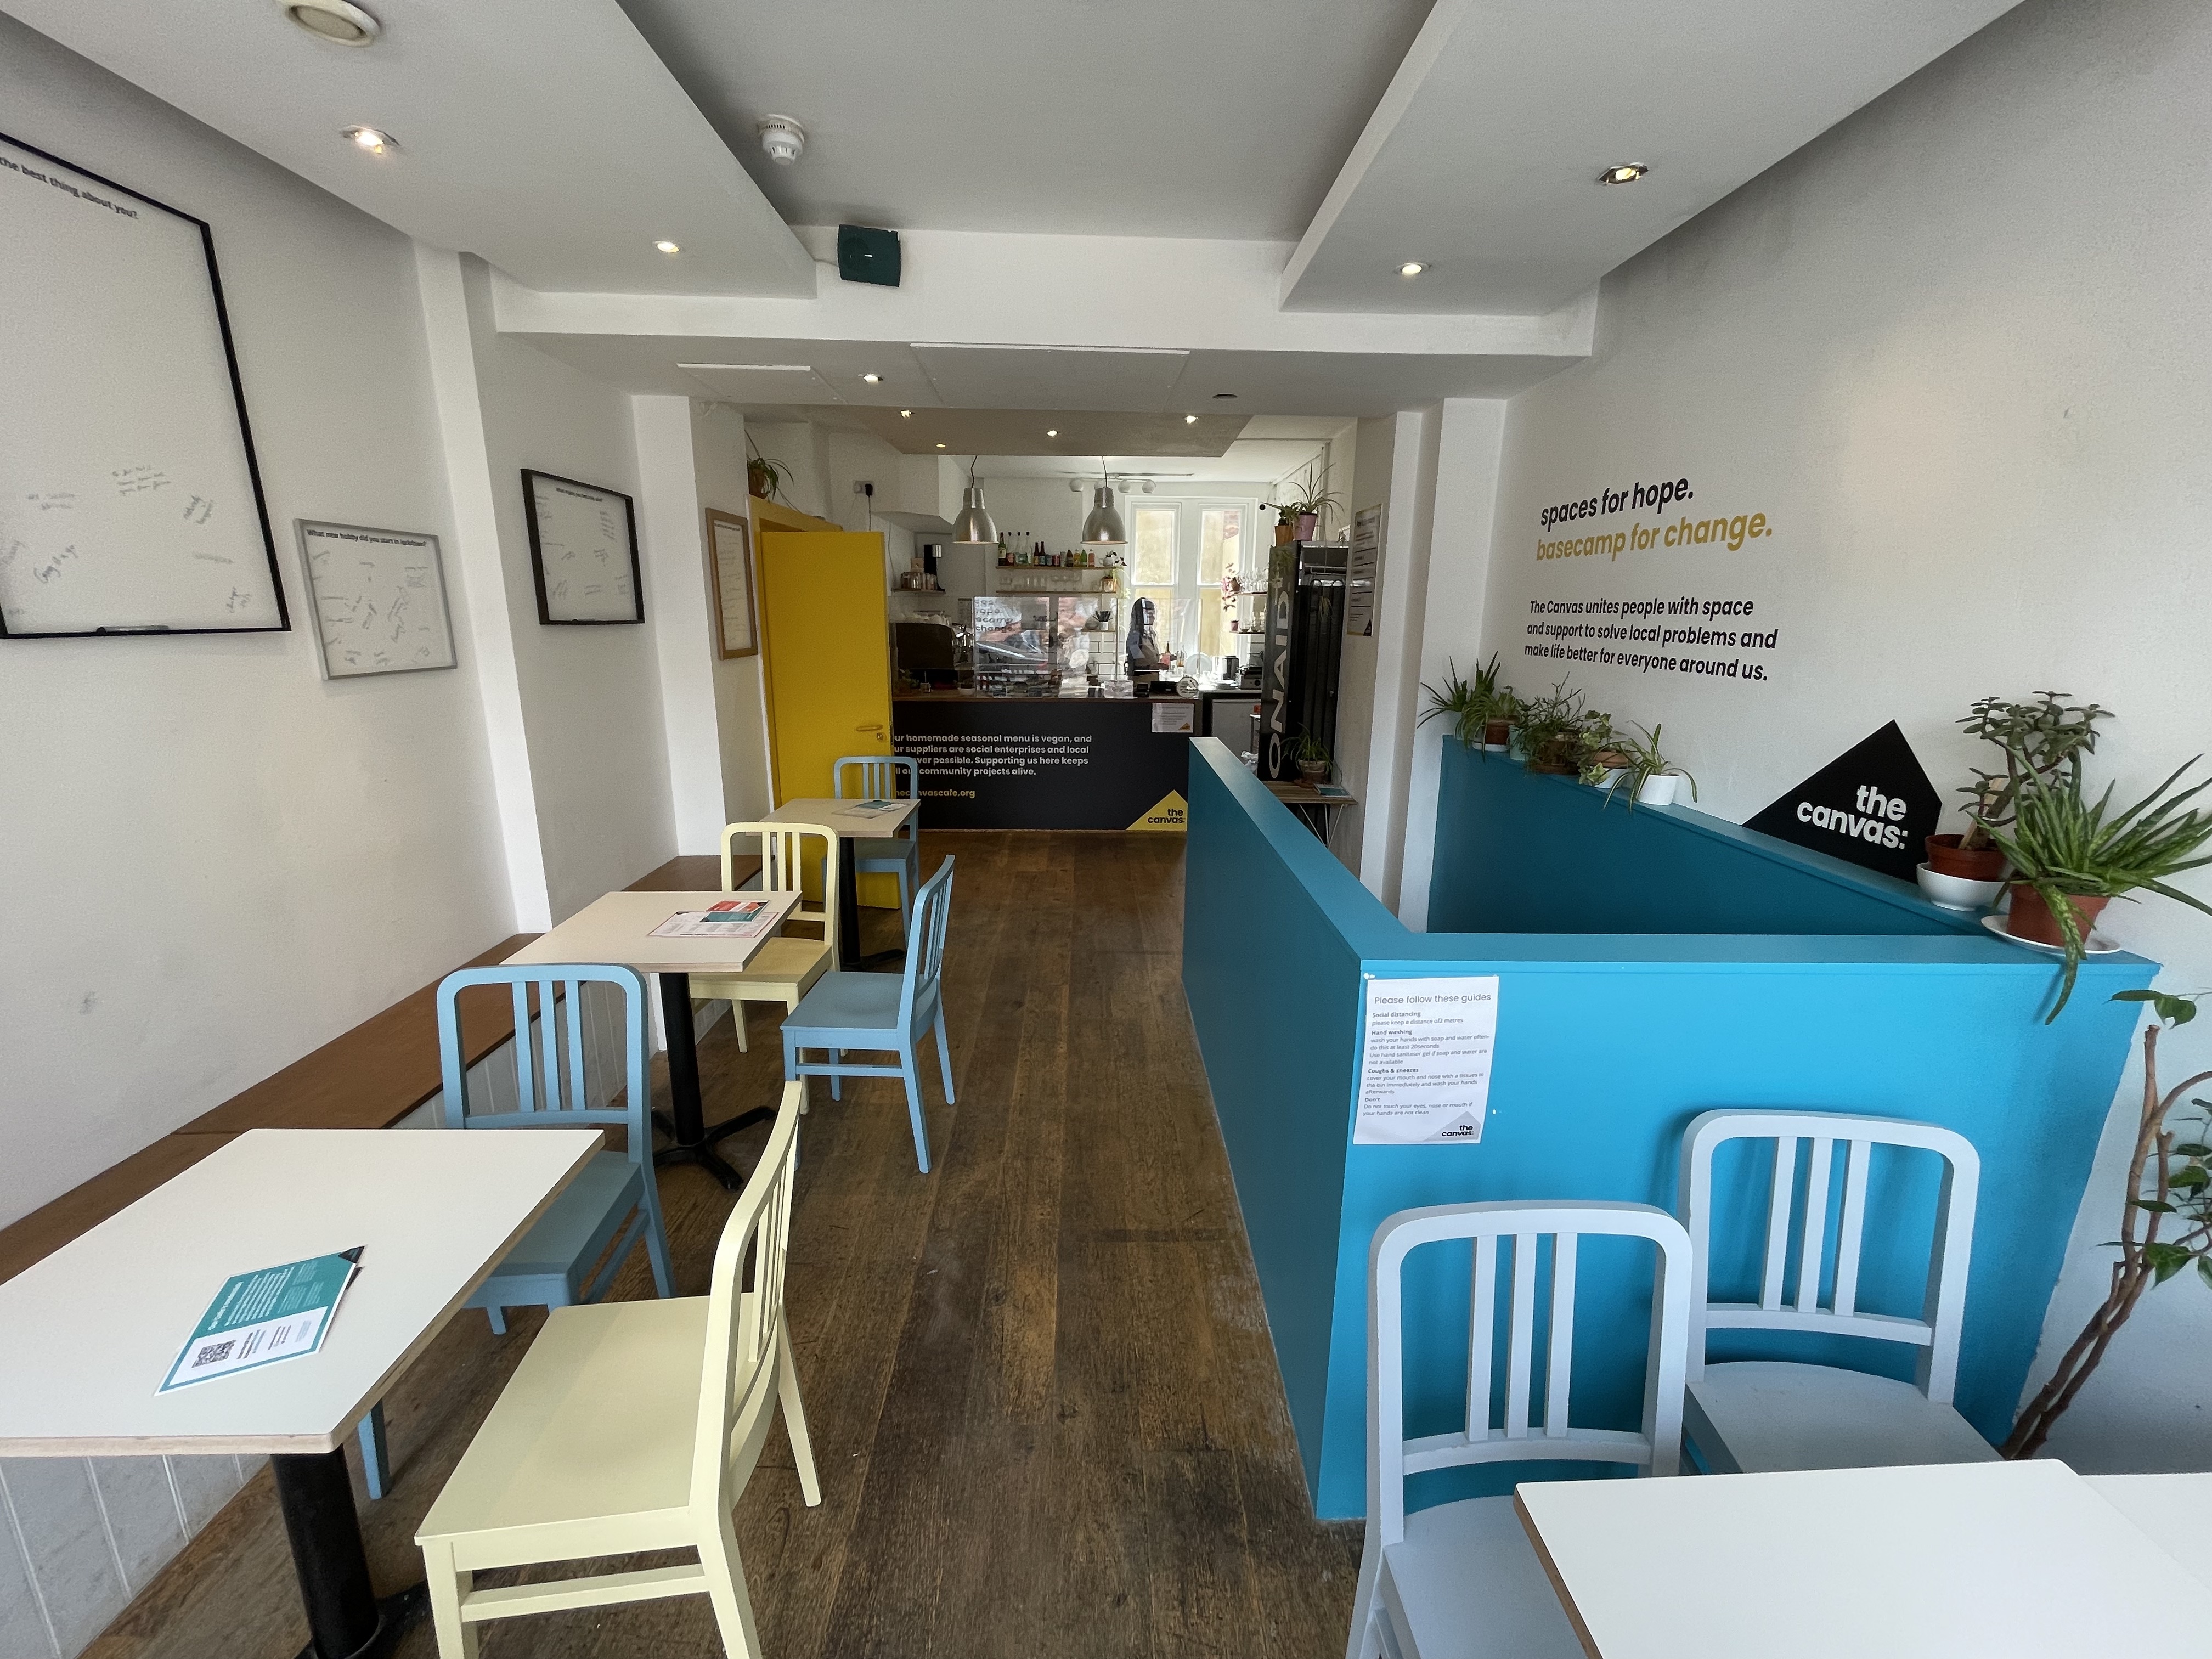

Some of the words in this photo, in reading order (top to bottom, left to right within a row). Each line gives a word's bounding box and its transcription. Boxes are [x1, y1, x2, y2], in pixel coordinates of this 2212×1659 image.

[21, 165, 49, 184] best
[49, 178, 80, 198] thing
[82, 191, 114, 210] about
[114, 205, 139, 219] you?
[1541, 497, 1598, 532] spaces
[1601, 487, 1629, 515] for
[1632, 478, 1694, 514] hope.
[1536, 531, 1626, 562] basecamp
[1630, 523, 1660, 552] for
[1664, 512, 1773, 551] change.
[1530, 600, 1545, 614] The
[1547, 600, 1584, 614] Canvas
[1585, 598, 1620, 614] unites
[1621, 598, 1664, 619] people
[1668, 596, 1699, 616] with
[1702, 600, 1754, 622] space
[1527, 622, 1544, 636] and
[1545, 624, 1583, 641] support
[1584, 624, 1595, 638] to
[1597, 624, 1627, 640] solve
[1629, 625, 1661, 642] local
[1662, 627, 1737, 648] problems
[1740, 629, 1779, 649] and
[1524, 644, 1550, 658] make
[1550, 644, 1565, 659] life
[1566, 645, 1598, 662] better
[1600, 648, 1616, 664] for
[1617, 653, 1677, 673] everyone
[1679, 659, 1739, 678] around
[1741, 664, 1768, 681] us.
[1269, 591, 1289, 778] ONAID
[905, 744, 947, 755] suppliers
[994, 745, 1046, 755] enterprises
[1031, 734, 1040, 742] is
[1041, 736, 1072, 744] vegan,
[919, 767, 972, 777] community
[973, 767, 1011, 777] projects
[1012, 767, 1036, 775] alive.
[933, 756, 974, 766] possible.
[975, 756, 1025, 766] Supporting
[1062, 757, 1088, 766] keeps
[1856, 785, 1907, 821] the
[1797, 802, 1909, 849] canvas:
[1462, 994, 1491, 1004] guides
